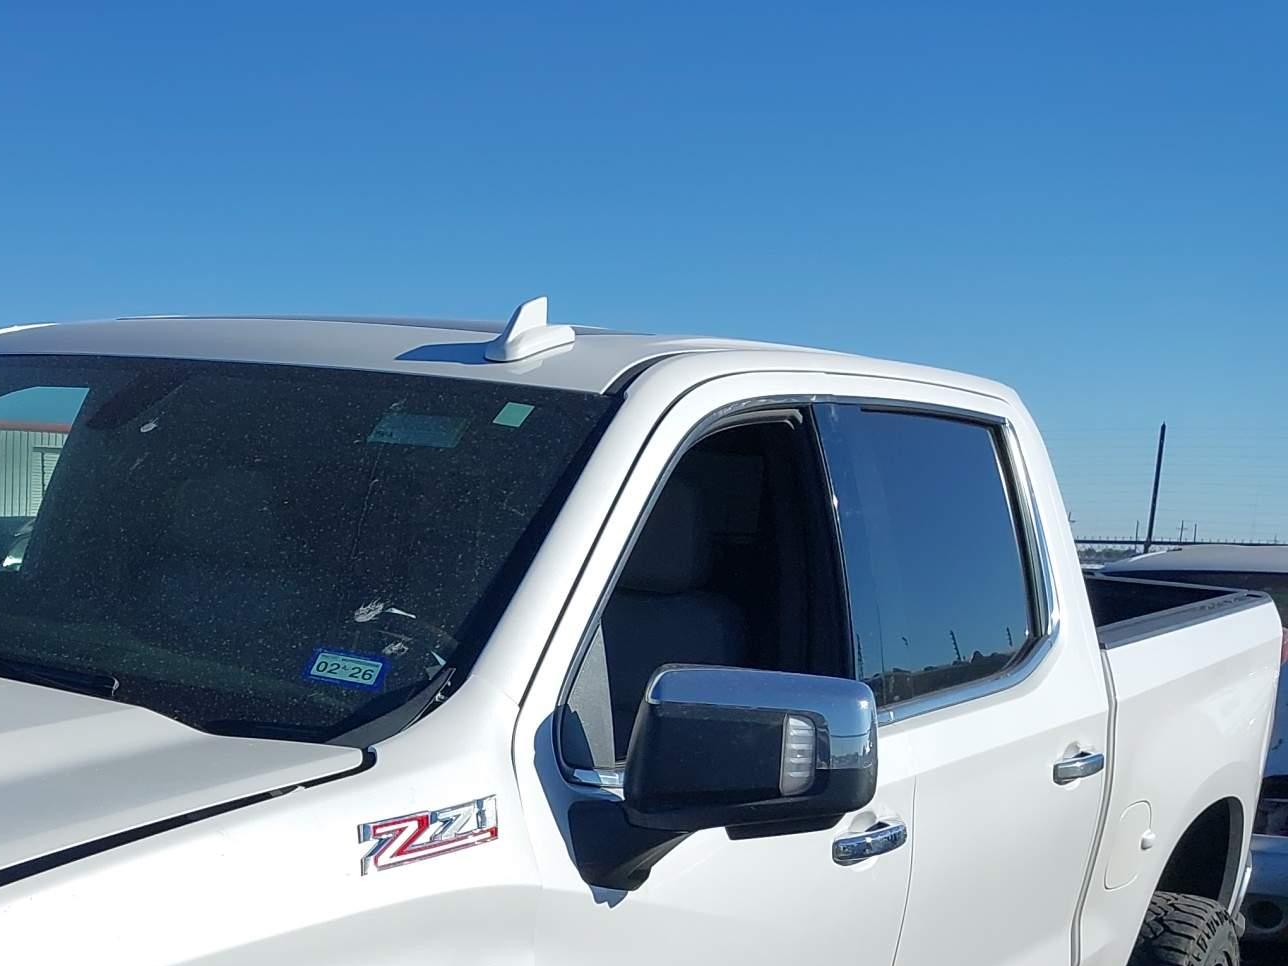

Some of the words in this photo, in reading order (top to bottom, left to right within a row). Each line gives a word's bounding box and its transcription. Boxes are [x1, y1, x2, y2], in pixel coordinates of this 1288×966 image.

[315, 661, 341, 675] 02
[348, 666, 375, 681] 26
[357, 794, 499, 877] Z71
